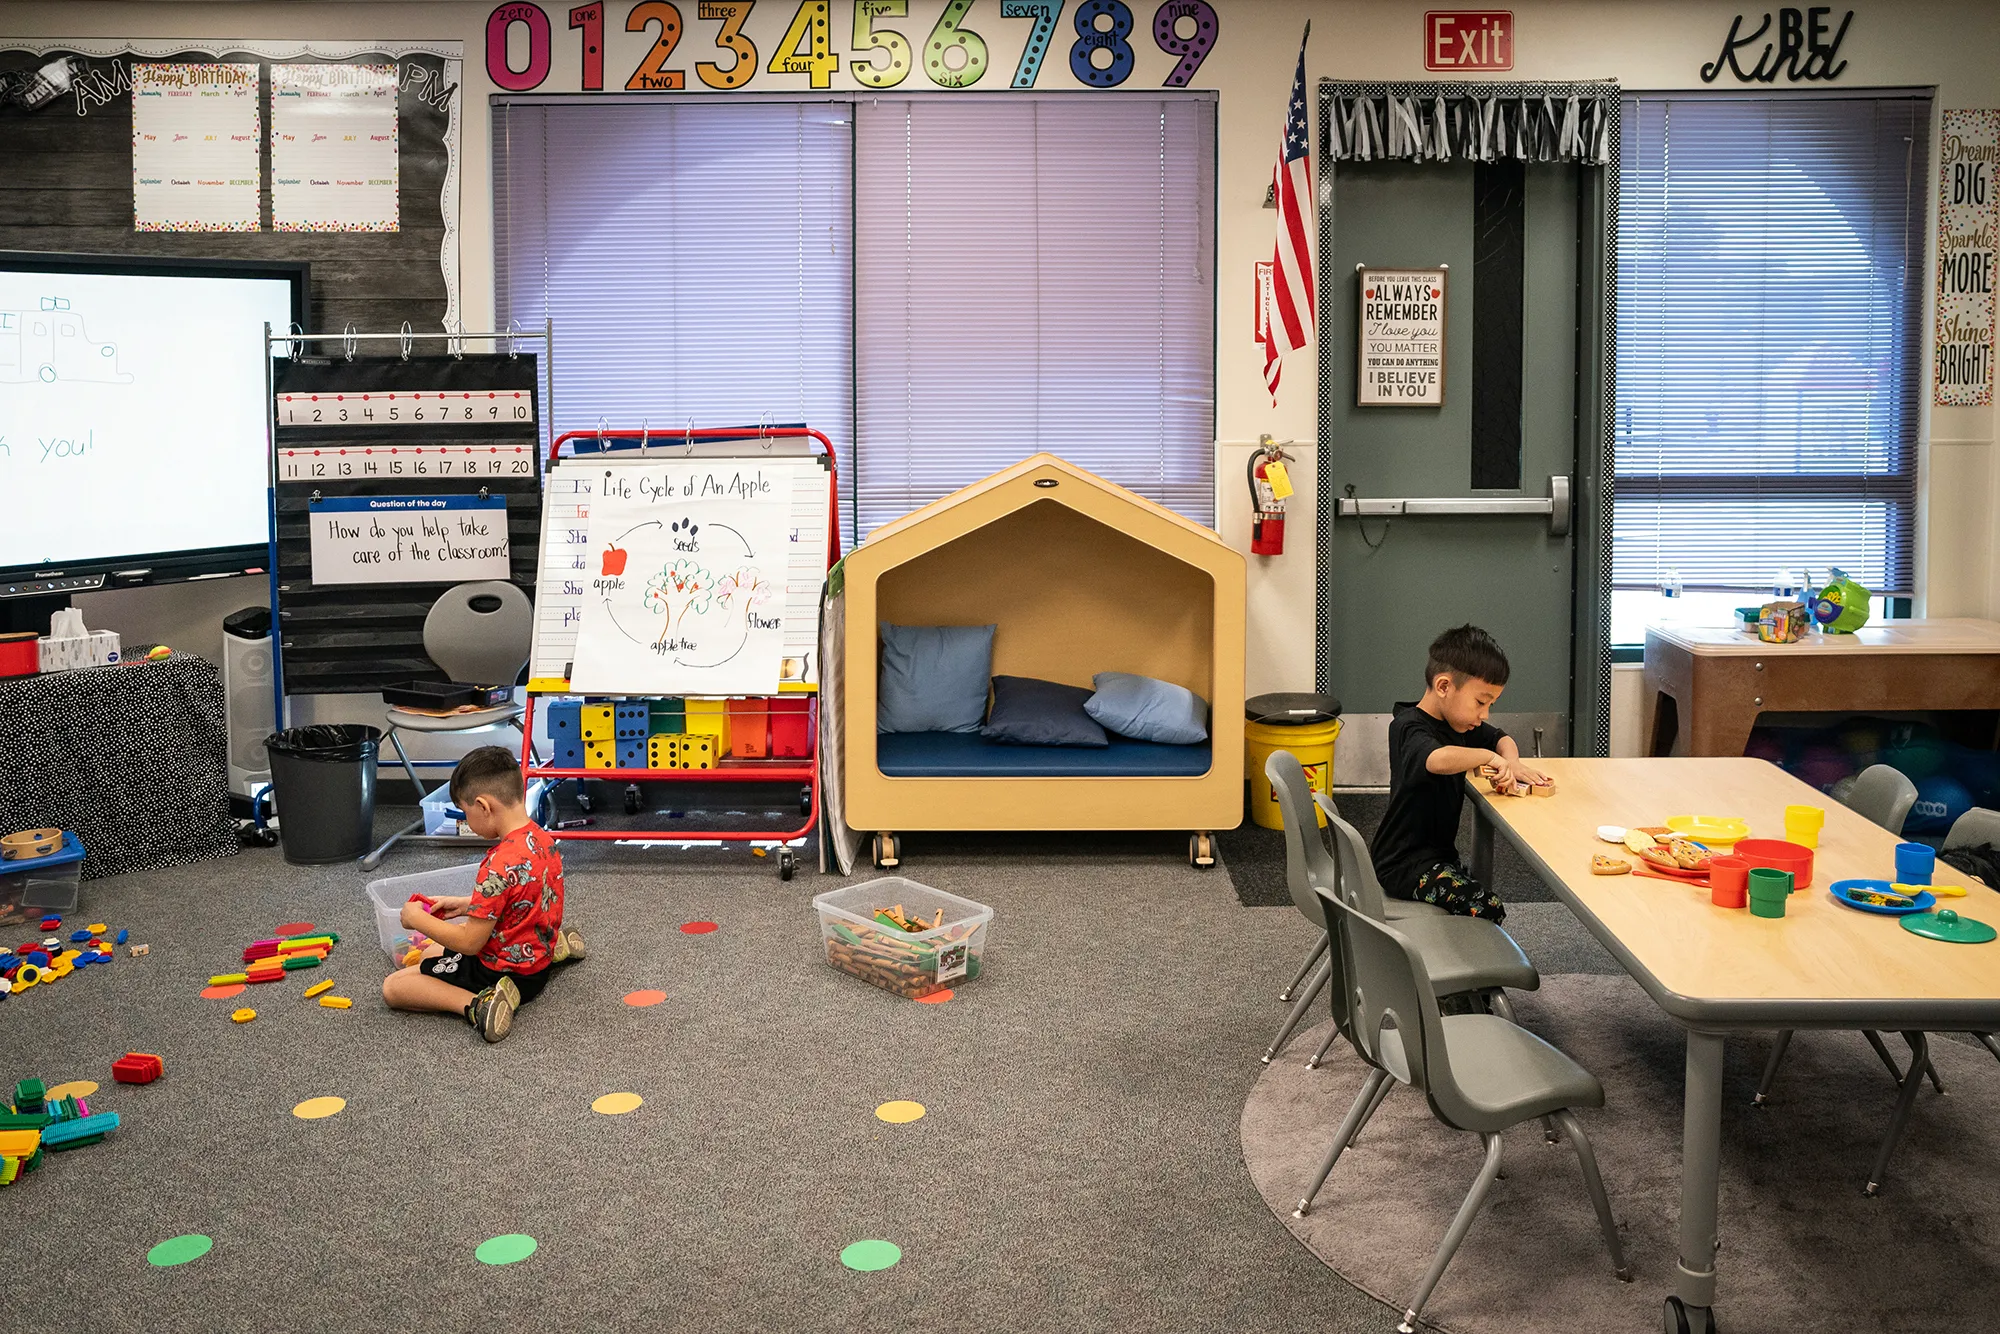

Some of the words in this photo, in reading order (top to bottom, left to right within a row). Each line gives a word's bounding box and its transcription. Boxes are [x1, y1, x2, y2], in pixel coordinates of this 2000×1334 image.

[498, 6, 534, 21] zero
[575, 10, 597, 22] one
[700, 4, 736, 18] three
[862, 1, 892, 17] five
[1168, 2, 1199, 18] nine
[1779, 7, 1830, 52] BE
[486, 1, 551, 92] 0
[569, 2, 604, 92] 1
[625, 0, 686, 91] 2
[695, 0, 758, 90] 3
[767, 0, 840, 89] 4
[850, 0, 913, 89] 5
[922, 0, 989, 89] 6
[1000, 0, 1065, 89] 7
[1069, 0, 1135, 89] 8
[1153, 0, 1219, 88] 9
[1084, 32, 1119, 48] eight
[1434, 17, 1503, 65] Exit
[1700, 10, 1854, 83] Kind
[782, 57, 815, 73] four
[73, 59, 132, 116] AM
[142, 70, 189, 89] Happy
[189, 71, 247, 84] BIRTHDAY
[282, 70, 328, 89] Happy
[328, 71, 386, 85] BIRTHDAY
[400, 63, 458, 112] PM
[640, 73, 673, 89] two
[231, 134, 250, 142] August
[370, 134, 390, 142] August
[1945, 135, 1996, 165] Dream
[1954, 162, 1985, 205] BIG
[1942, 222, 1994, 255] Sparkle
[1258, 268, 1273, 276] FIR
[1941, 252, 1993, 293] MORE
[1374, 284, 1431, 302] ALWAYS
[1366, 303, 1438, 321] REMEMBER
[1381, 322, 1411, 336] love
[1410, 328, 1438, 340] you
[1940, 314, 1989, 344] Shine
[1370, 343, 1392, 353] YOU
[1395, 343, 1438, 353] MATTER
[1368, 358, 1381, 366] YOU
[1382, 358, 1395, 366] CAN
[1396, 358, 1404, 366] DO
[1405, 358, 1439, 366] ANYTHING
[1939, 344, 1990, 385] BRIGHT
[1369, 372, 1373, 383] I
[1377, 372, 1436, 384] BELIEVE
[1378, 385, 1392, 397] IN
[1397, 385, 1427, 397] YOU
[289, 410, 293, 422] 1
[313, 410, 322, 422] 2
[339, 409, 348, 421] 3
[363, 408, 374, 421] 4
[389, 408, 399, 420] 5
[414, 408, 423, 420] 6
[439, 407, 449, 420] 7
[464, 407, 473, 419] 8
[489, 406, 498, 419] 9
[513, 406, 527, 419] 10
[38, 429, 93, 464] you!
[288, 464, 298, 477] 11
[311, 464, 325, 476] 12
[338, 463, 352, 476] 13
[364, 462, 378, 475] 14
[389, 462, 403, 474] 15
[414, 462, 427, 474] 16
[439, 461, 452, 474] 17
[463, 461, 476, 474] 18
[488, 461, 501, 473] 19
[511, 461, 529, 473] 20
[603, 479, 631, 499] Life
[639, 476, 675, 502] Cycle
[683, 477, 697, 496] of
[701, 474, 724, 496] An
[728, 471, 771, 499] Apple
[370, 499, 406, 509] Question
[431, 500, 447, 509] day
[329, 520, 359, 539] How
[370, 517, 386, 537] do
[392, 526, 414, 543] you
[421, 516, 450, 543] help
[457, 516, 490, 537] take
[353, 549, 381, 564] care
[388, 542, 403, 561] of
[410, 542, 430, 561] the
[438, 538, 510, 562] classroom?
[672, 536, 700, 552] seeds
[593, 578, 625, 596] apple
[650, 638, 679, 656] apple
[678, 638, 697, 652] tree
